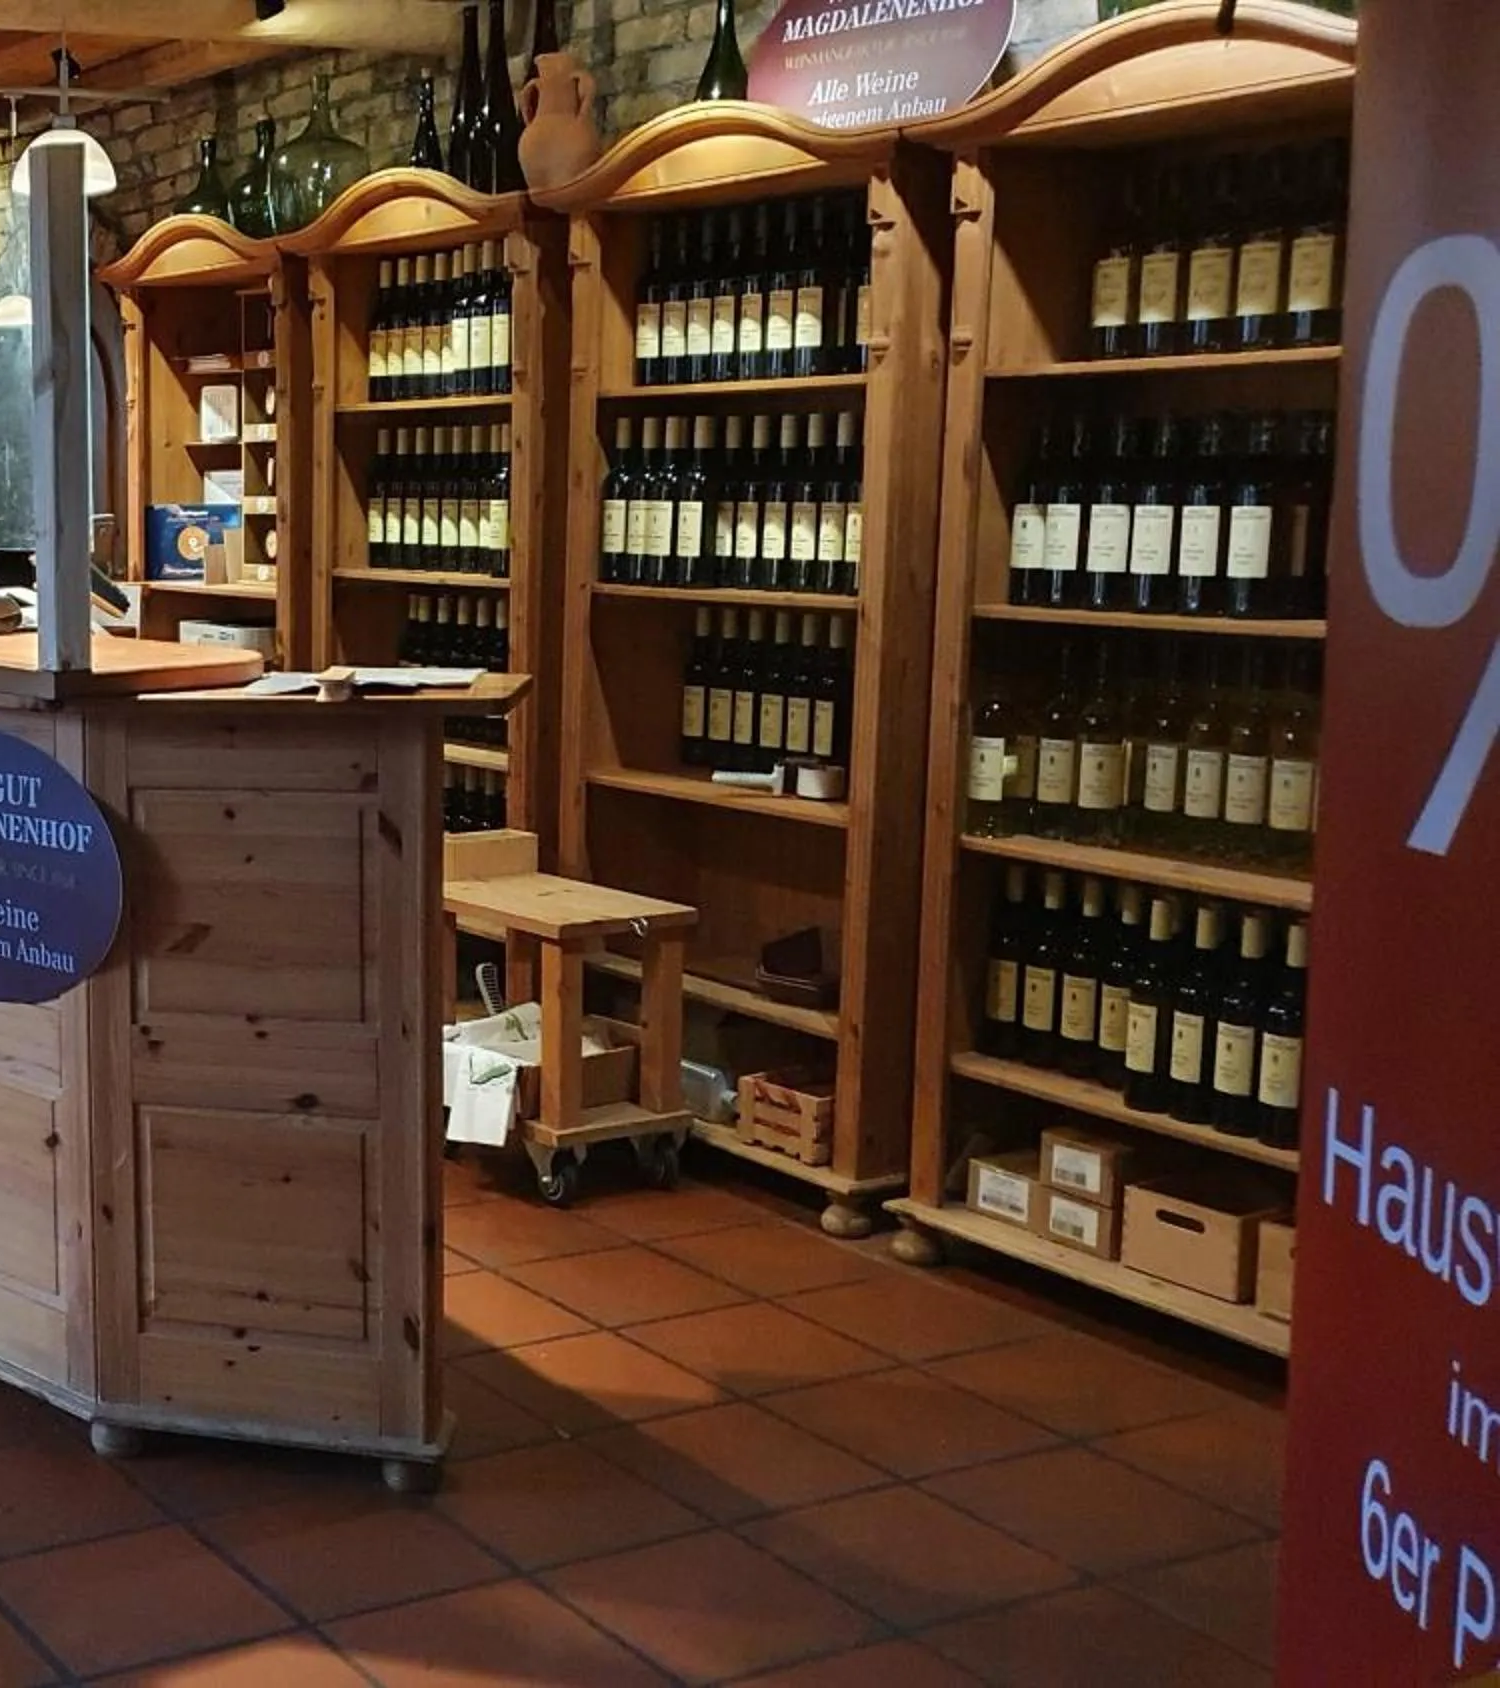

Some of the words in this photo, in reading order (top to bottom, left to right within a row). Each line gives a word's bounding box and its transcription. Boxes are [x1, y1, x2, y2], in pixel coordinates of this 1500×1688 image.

[783, 0, 985, 42] MAGDALENEN
[807, 79, 849, 106] Alle
[856, 70, 920, 97] Weine
[887, 95, 948, 121] Anbau
[15, 940, 76, 974] Anbau
[1323, 1087, 1500, 1307] Haus
[1361, 1459, 1441, 1630] 6er
[1453, 1544, 1500, 1672] P
